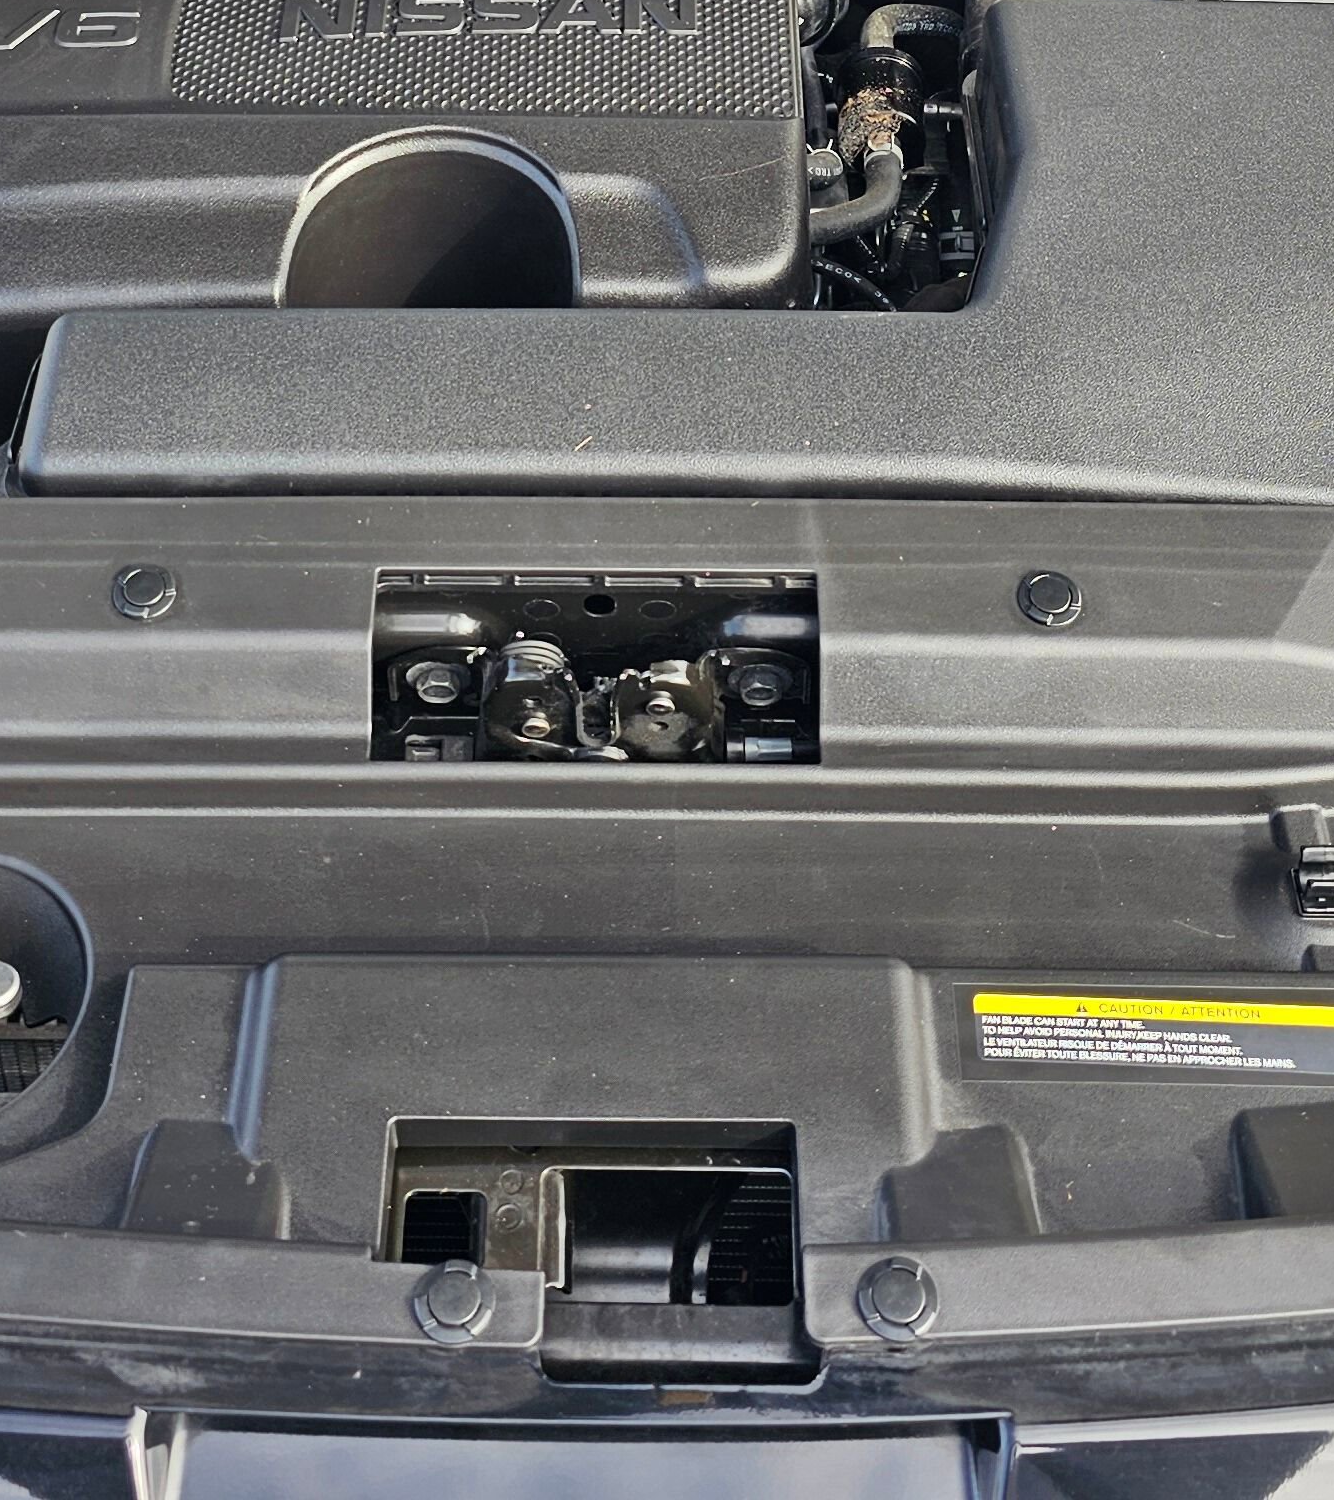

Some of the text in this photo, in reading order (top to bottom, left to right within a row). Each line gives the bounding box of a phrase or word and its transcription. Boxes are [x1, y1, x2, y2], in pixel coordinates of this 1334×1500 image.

[1098, 1003, 1164, 1015] CAUTION
[1181, 1006, 1261, 1019] ATTENTION
[981, 1015, 1146, 1030] FAN BLADE CAN START AT ANY TIME.
[981, 1025, 996, 1035] TO
[997, 1026, 1022, 1035] HELP
[1023, 1027, 1053, 1036] AVOID
[1053, 1028, 1105, 1039] PERSONAL
[1163, 1031, 1197, 1043] HANDS
[1198, 1033, 1233, 1044] CLEAR.
[983, 1037, 1244, 1056] LE VENTILATEUR RISQUE DE DÉMARRER À TOUT MOMENT.
[984, 1045, 1297, 1069] POUR ÉVITER TOUTE BLESSURE, NE PAS EN APPROCHER LES MAINS.
